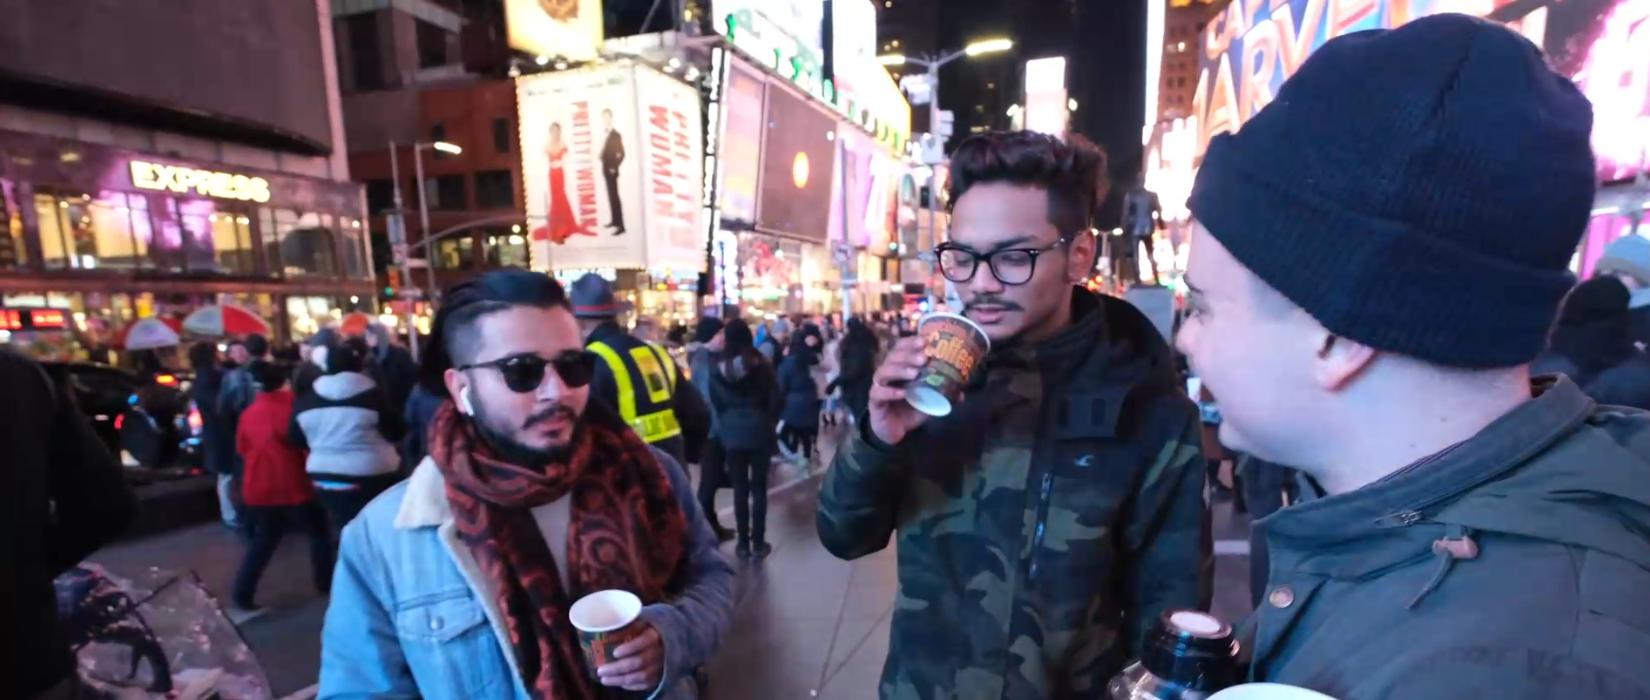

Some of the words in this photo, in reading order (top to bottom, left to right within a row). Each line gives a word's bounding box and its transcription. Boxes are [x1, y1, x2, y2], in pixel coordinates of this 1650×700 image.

[130, 160, 271, 203] EXPRESS
[649, 104, 674, 218] WOMAN
[576, 167, 598, 228] WOMAN
[924, 331, 974, 377] Coffee
